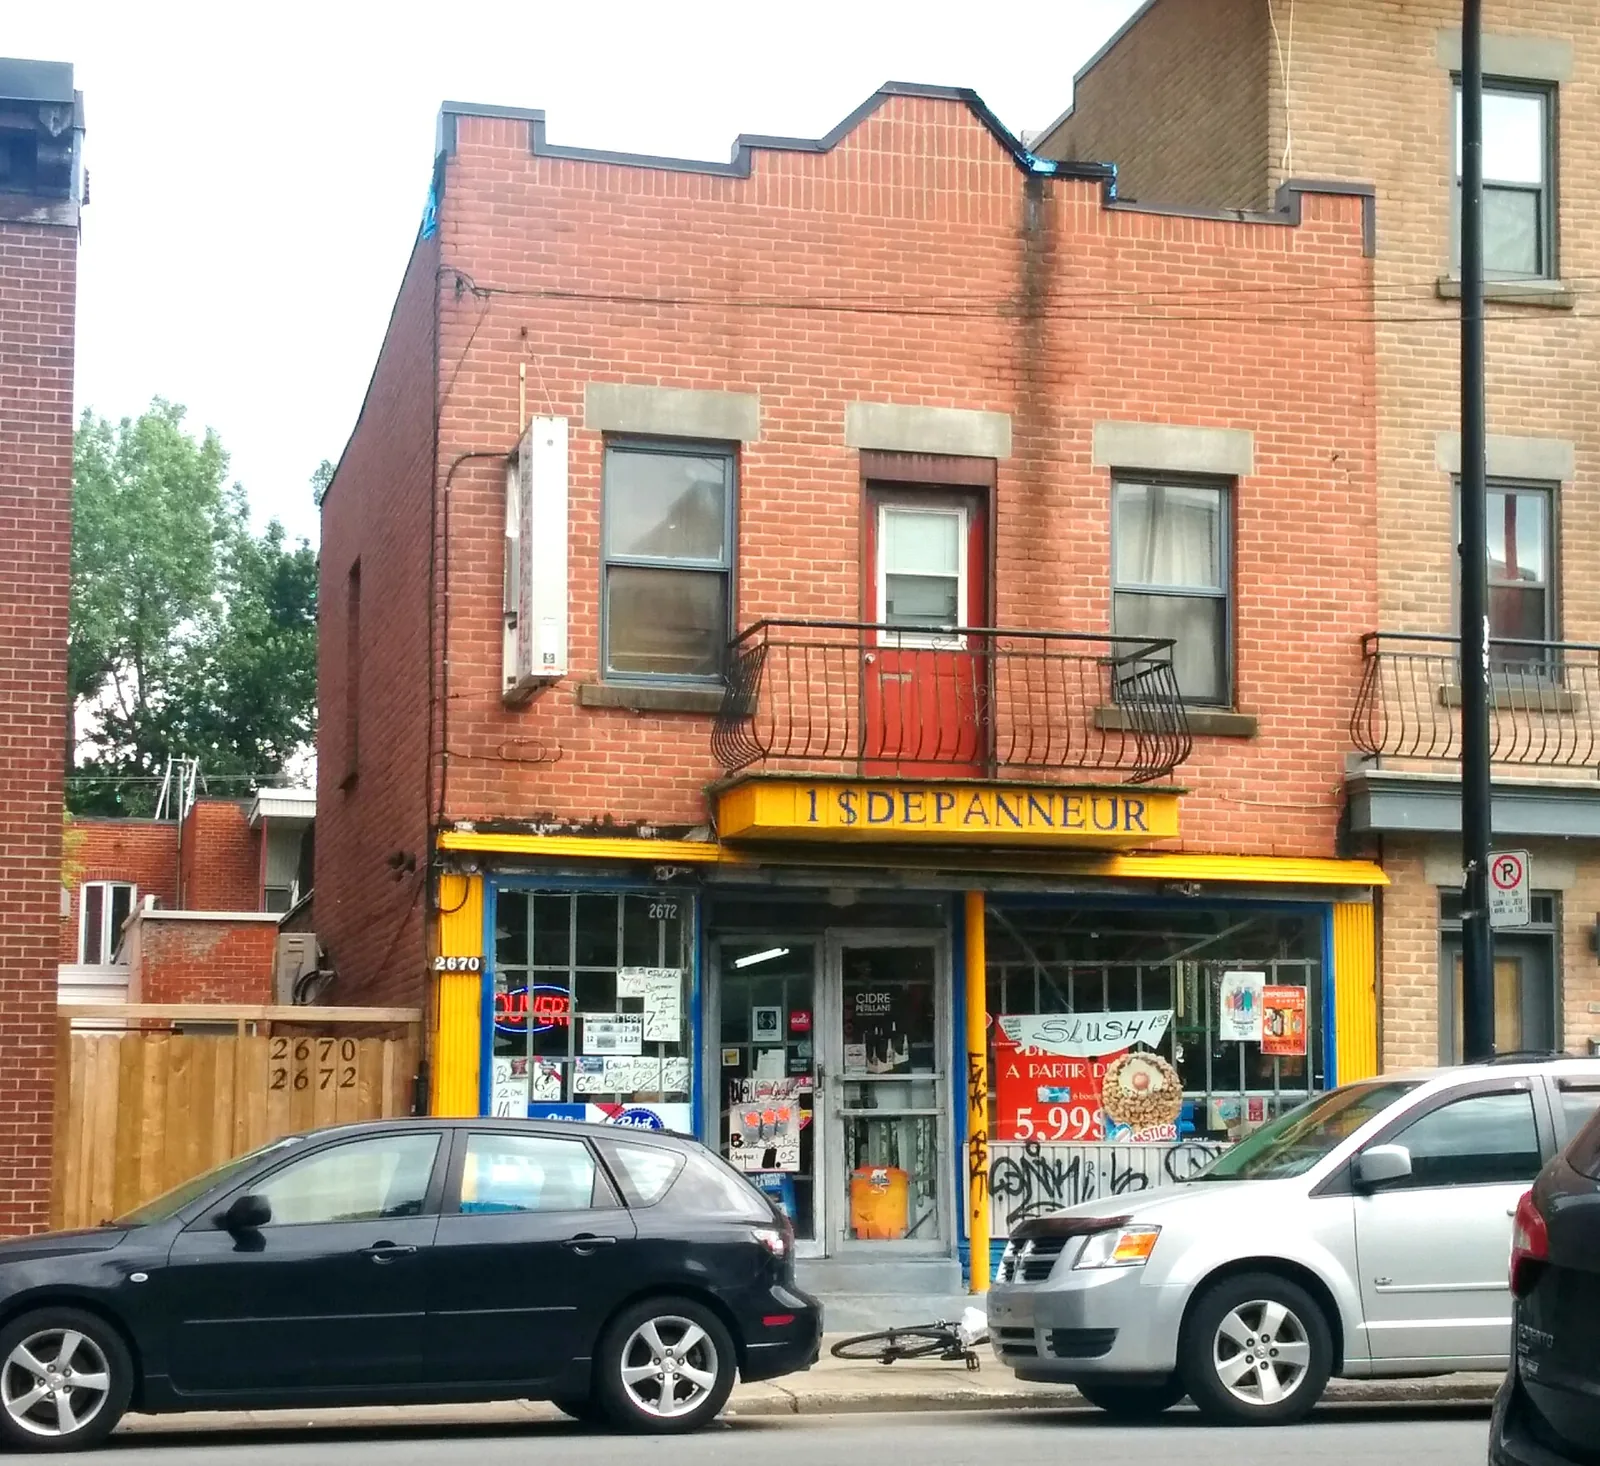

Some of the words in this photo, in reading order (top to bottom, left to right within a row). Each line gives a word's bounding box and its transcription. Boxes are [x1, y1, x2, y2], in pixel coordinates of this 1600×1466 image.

[649, 903, 678, 919] 2672
[434, 956, 480, 971] 2670
[855, 993, 891, 1004] CIDRE
[1031, 1018, 1144, 1044] SLUSH
[270, 1038, 356, 1062] 2670
[270, 1066, 357, 1091] 2672
[1028, 1063, 1087, 1079] PARTIR
